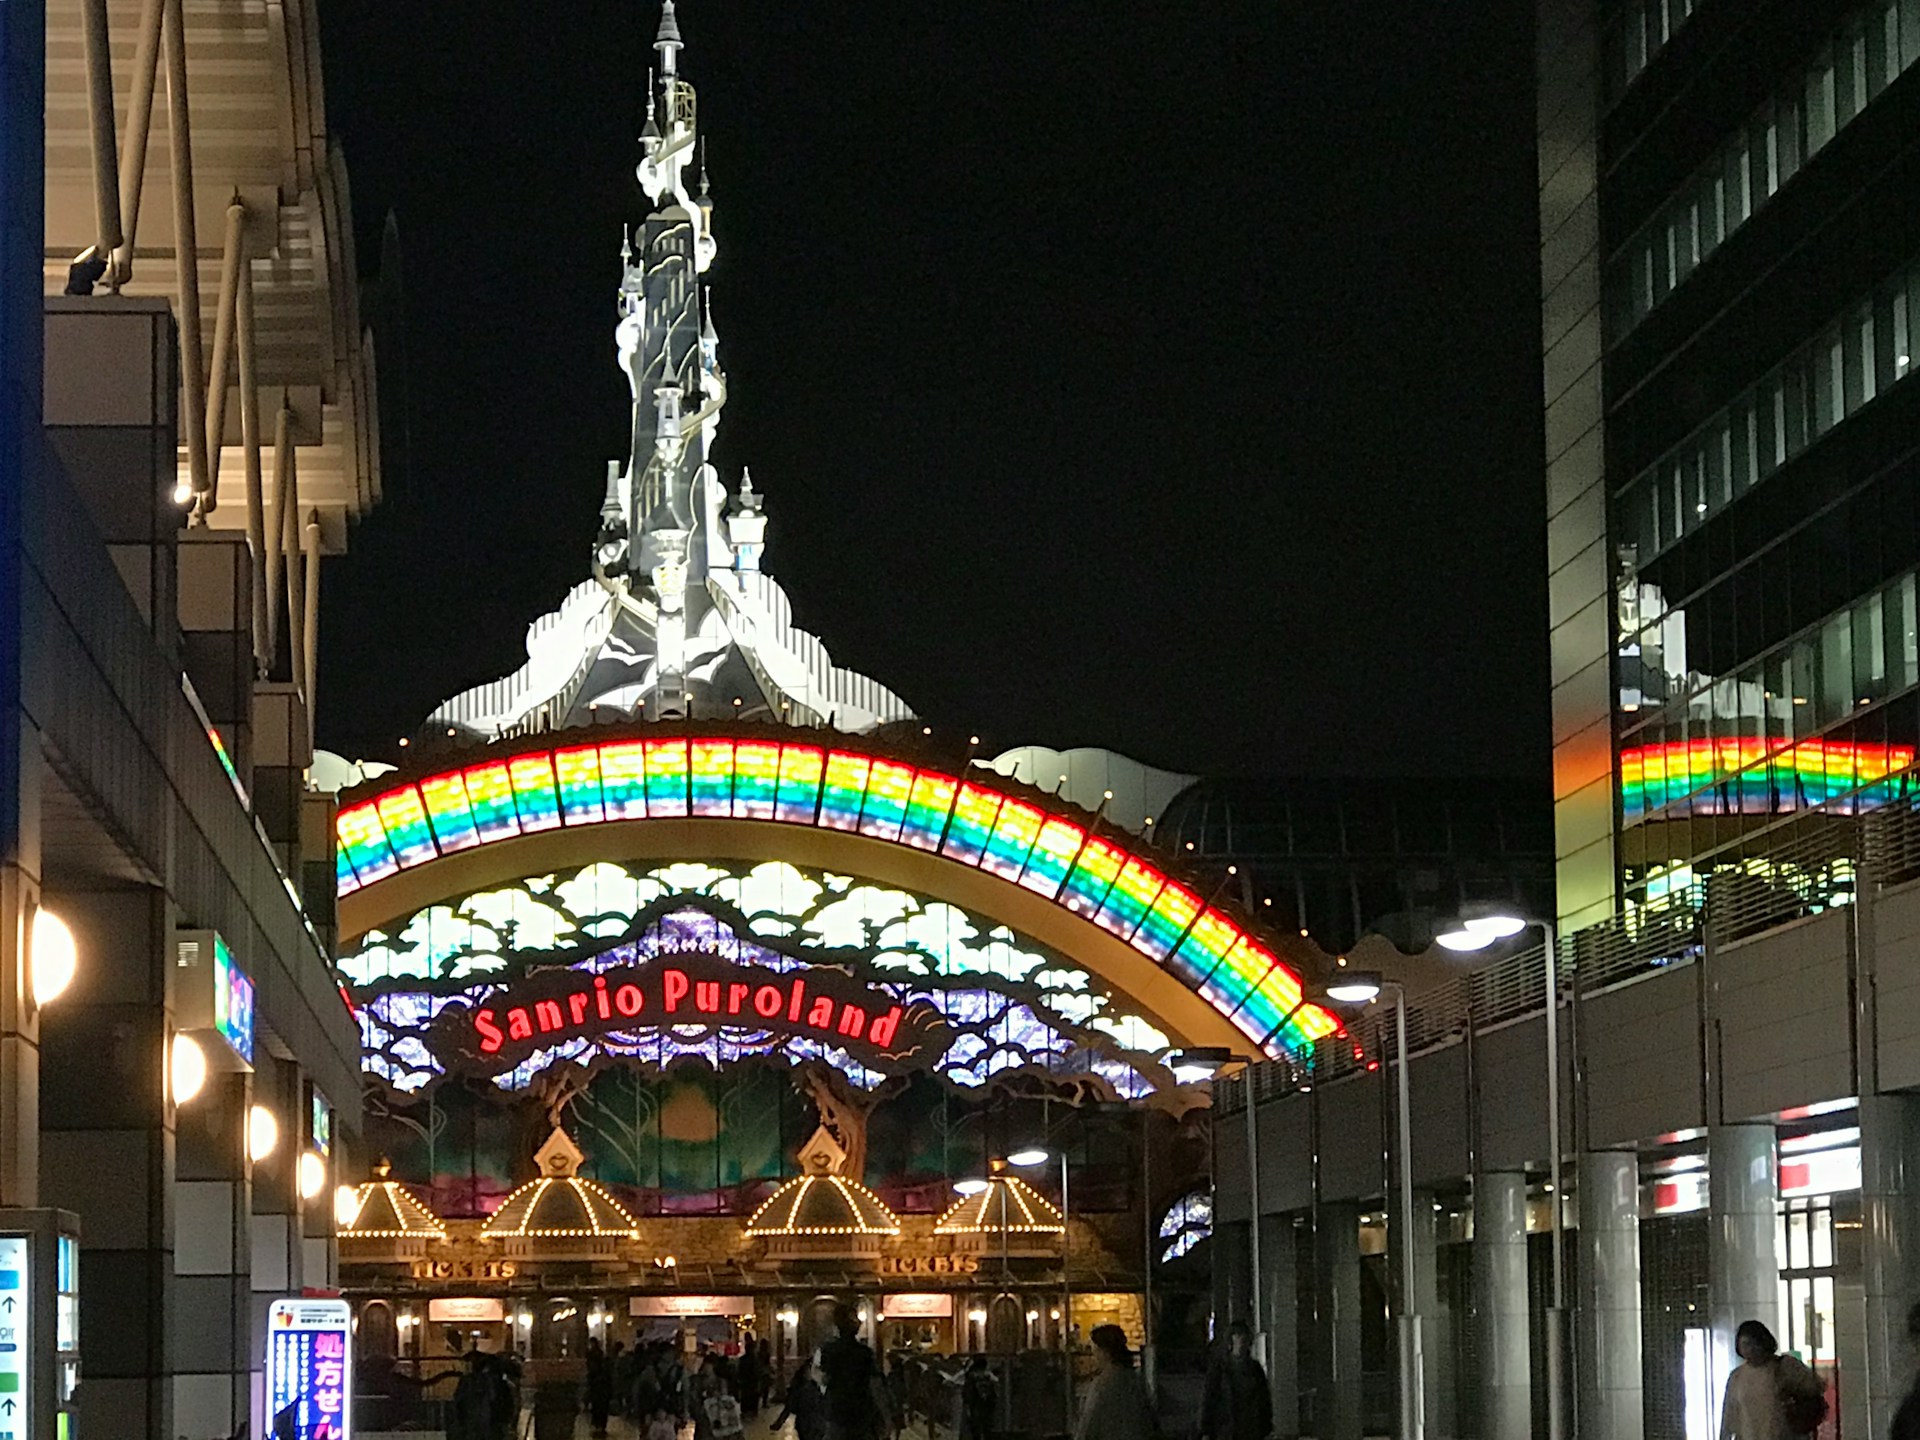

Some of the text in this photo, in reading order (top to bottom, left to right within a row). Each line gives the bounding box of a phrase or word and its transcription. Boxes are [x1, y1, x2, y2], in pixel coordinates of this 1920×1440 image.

[473, 969, 905, 1055] Sanrio Puroland
[412, 1261, 517, 1278] TICKETS
[877, 1256, 978, 1274] TICKETS
